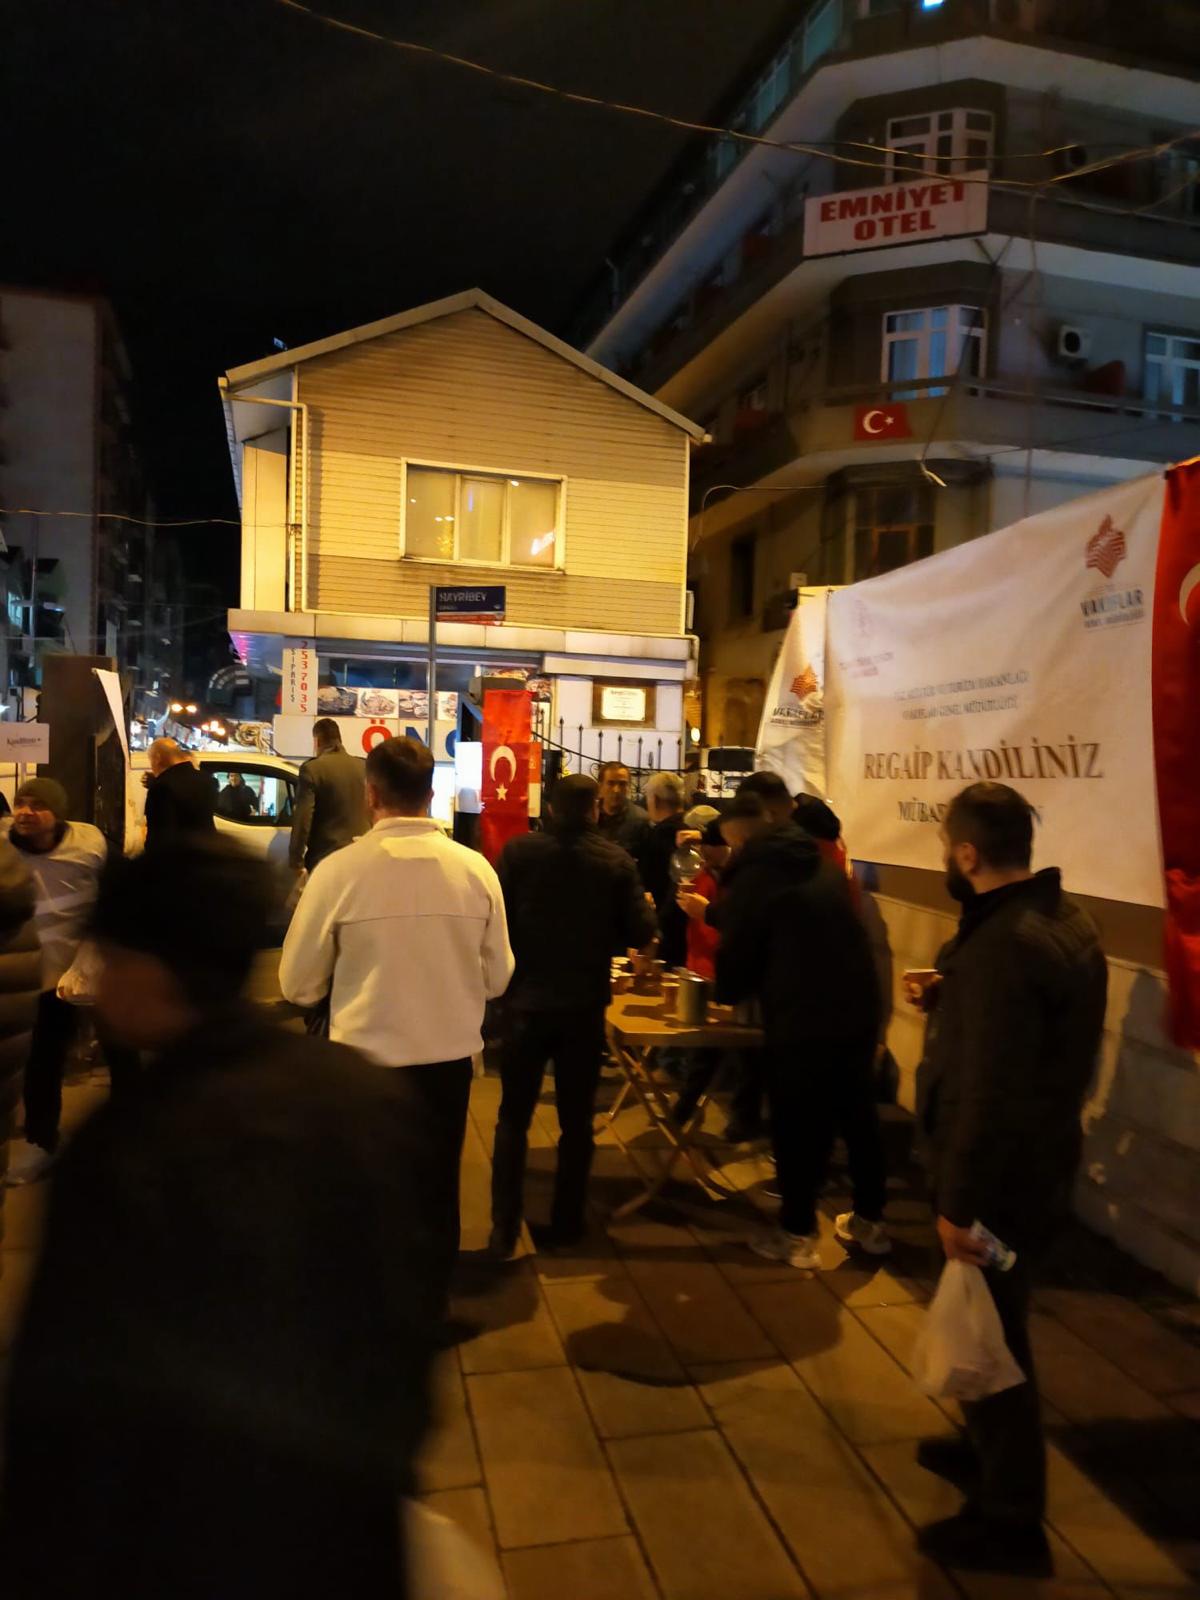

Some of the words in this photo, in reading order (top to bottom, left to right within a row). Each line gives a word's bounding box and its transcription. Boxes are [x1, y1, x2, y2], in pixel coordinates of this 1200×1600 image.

[820, 181, 964, 222] EMNİYET
[854, 210, 936, 241] OTEL
[864, 745, 934, 780] REGAİP
[937, 735, 1104, 780] KANDİLİNİZ
